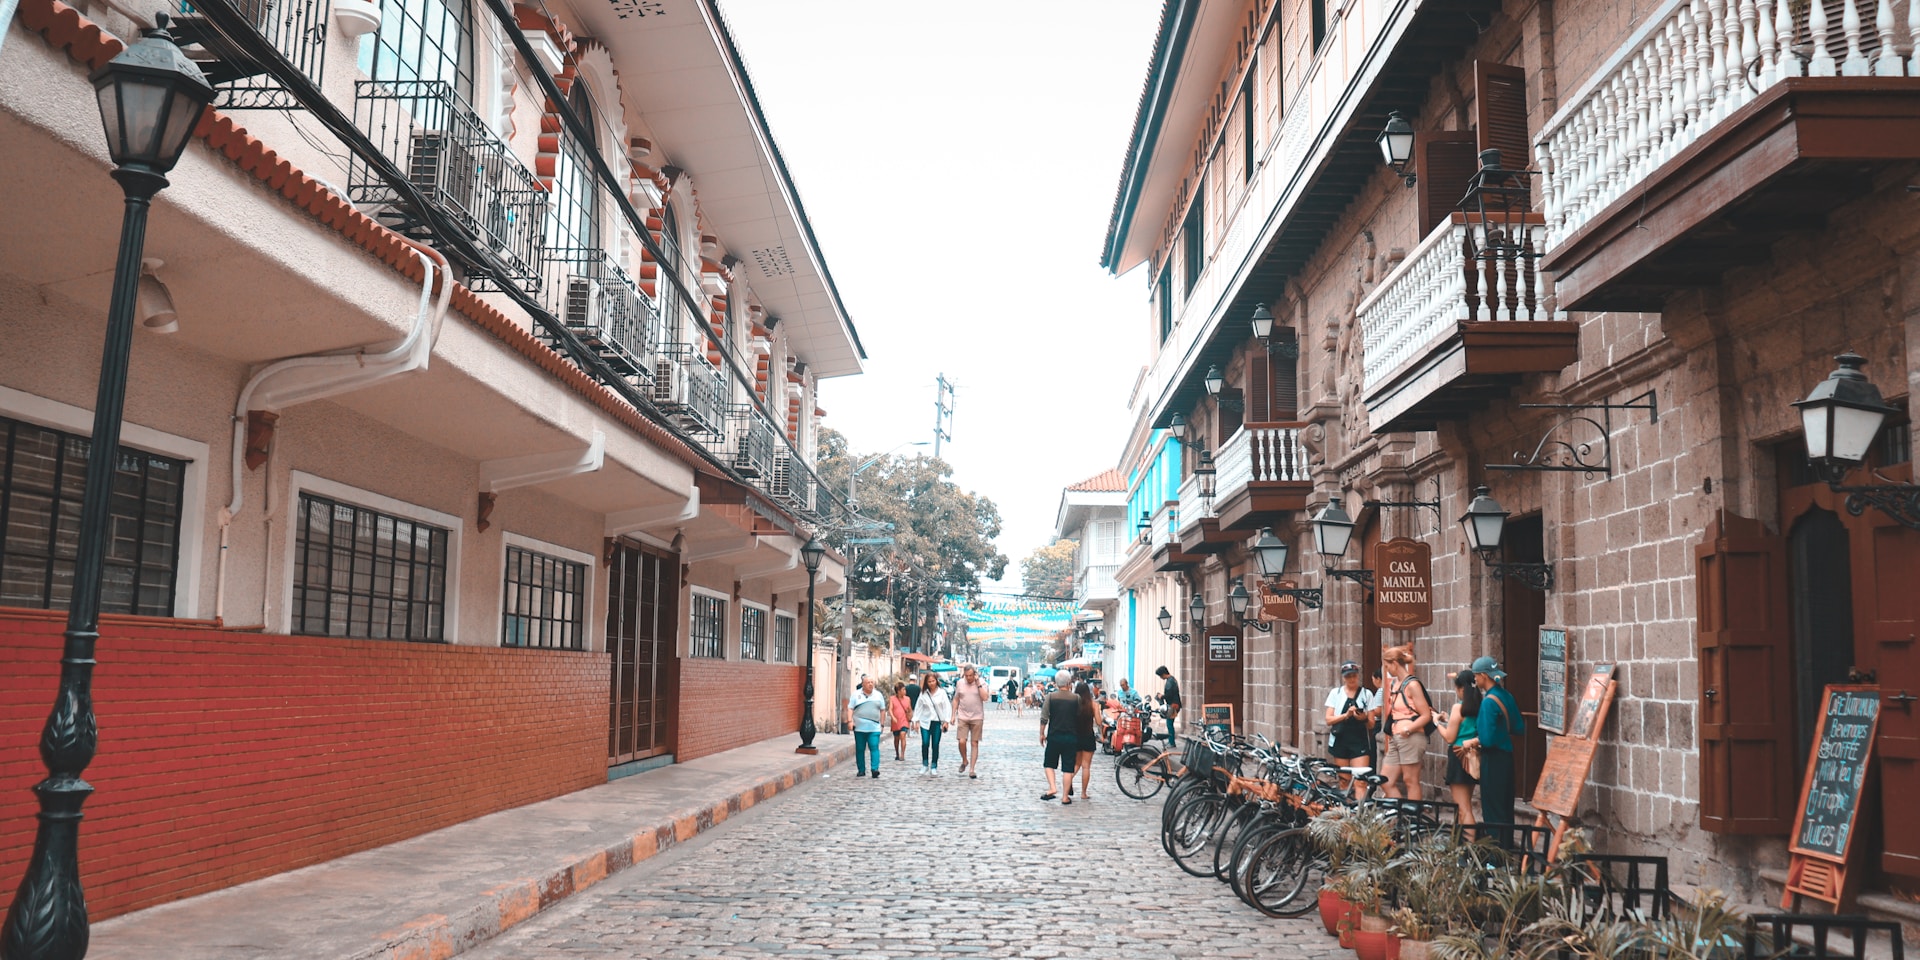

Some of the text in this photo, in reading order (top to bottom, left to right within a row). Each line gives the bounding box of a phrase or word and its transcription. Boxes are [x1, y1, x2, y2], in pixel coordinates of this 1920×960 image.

[1389, 561, 1416, 573] CASA
[1382, 576, 1425, 588] MANILA
[1379, 591, 1427, 603] MUSEUM
[1830, 741, 1860, 760] COFFEE
[1839, 760, 1852, 782] Tea
[1802, 815, 1836, 847] Juices
